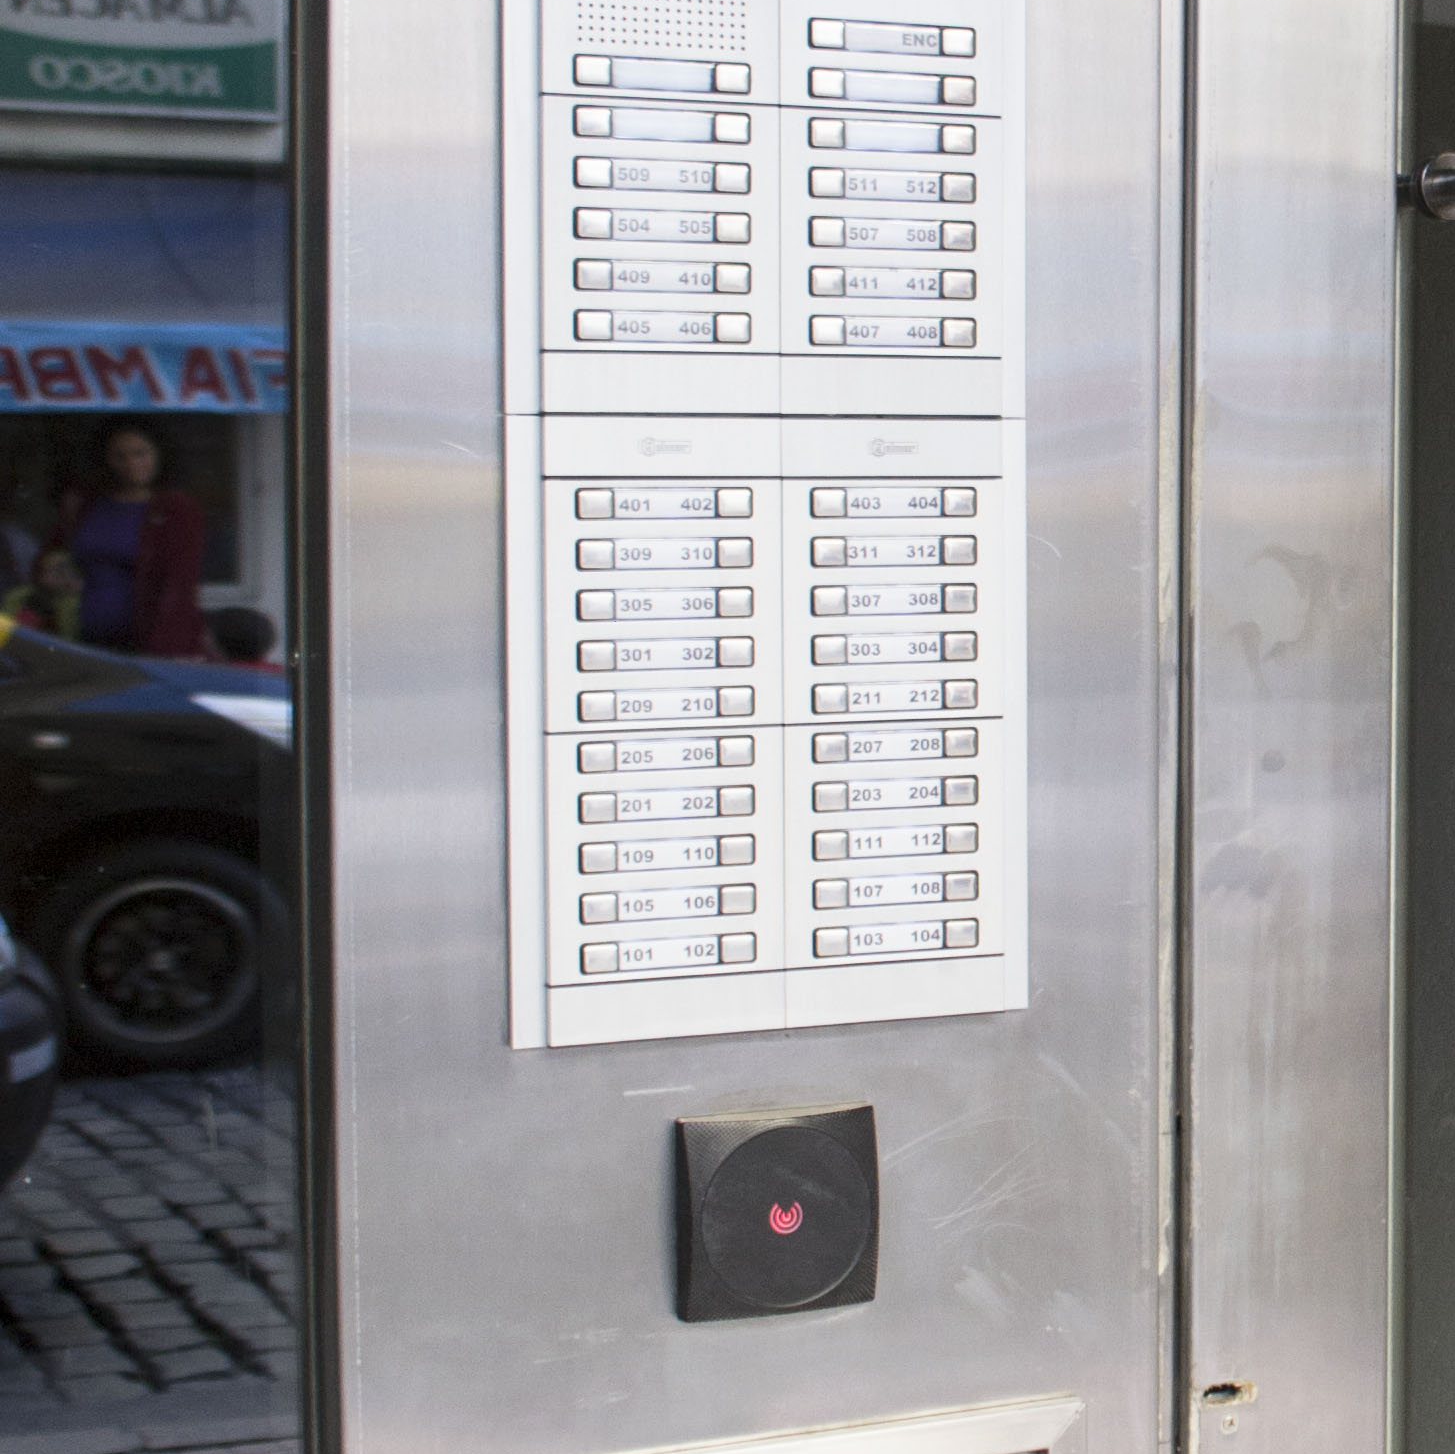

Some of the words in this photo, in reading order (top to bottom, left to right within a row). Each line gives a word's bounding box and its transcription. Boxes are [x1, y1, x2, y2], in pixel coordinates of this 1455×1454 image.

[901, 32, 938, 48] ENC
[617, 167, 650, 183] 509
[678, 169, 712, 185] 510
[847, 177, 878, 192] 511
[905, 180, 938, 195] 512
[617, 218, 651, 233] 504
[678, 219, 712, 235] 505
[848, 227, 879, 241] 507
[906, 228, 938, 243] 508
[617, 269, 650, 285] 409
[678, 271, 712, 287] 410
[848, 277, 879, 291] 411
[905, 277, 938, 292] 412
[617, 320, 651, 335] 405
[678, 321, 712, 336] 406
[848, 325, 881, 339] 407
[906, 325, 938, 339] 408
[618, 496, 652, 513] 401
[680, 497, 714, 512] 402
[850, 496, 881, 511] 403
[907, 495, 939, 510] 404
[619, 547, 653, 562] 309
[680, 546, 713, 561] 310
[847, 545, 880, 560] 311
[906, 544, 937, 559] 312
[620, 598, 653, 613] 305
[681, 597, 714, 612] 306
[851, 594, 881, 608] 307
[908, 592, 939, 607] 308
[620, 648, 653, 663] 301
[681, 646, 715, 662] 302
[850, 642, 881, 657] 303
[907, 641, 939, 656] 304
[620, 699, 654, 714] 209
[681, 697, 714, 713] 210
[851, 691, 882, 706] 211
[908, 689, 940, 704] 212
[852, 739, 884, 755] 207
[910, 737, 941, 753] 208
[621, 750, 654, 765] 205
[681, 746, 715, 762] 206
[851, 787, 882, 803] 203
[908, 785, 940, 800] 204
[621, 798, 653, 813] 201
[681, 796, 715, 811] 202
[854, 835, 884, 851] 111
[910, 832, 942, 847] 112
[622, 848, 655, 864] 109
[683, 846, 715, 862] 110
[853, 884, 884, 899] 107
[910, 881, 941, 896] 108
[622, 898, 655, 914] 105
[683, 894, 716, 910] 106
[853, 932, 884, 947] 103
[910, 928, 941, 943] 104
[622, 947, 654, 963] 101
[683, 943, 716, 958] 102
